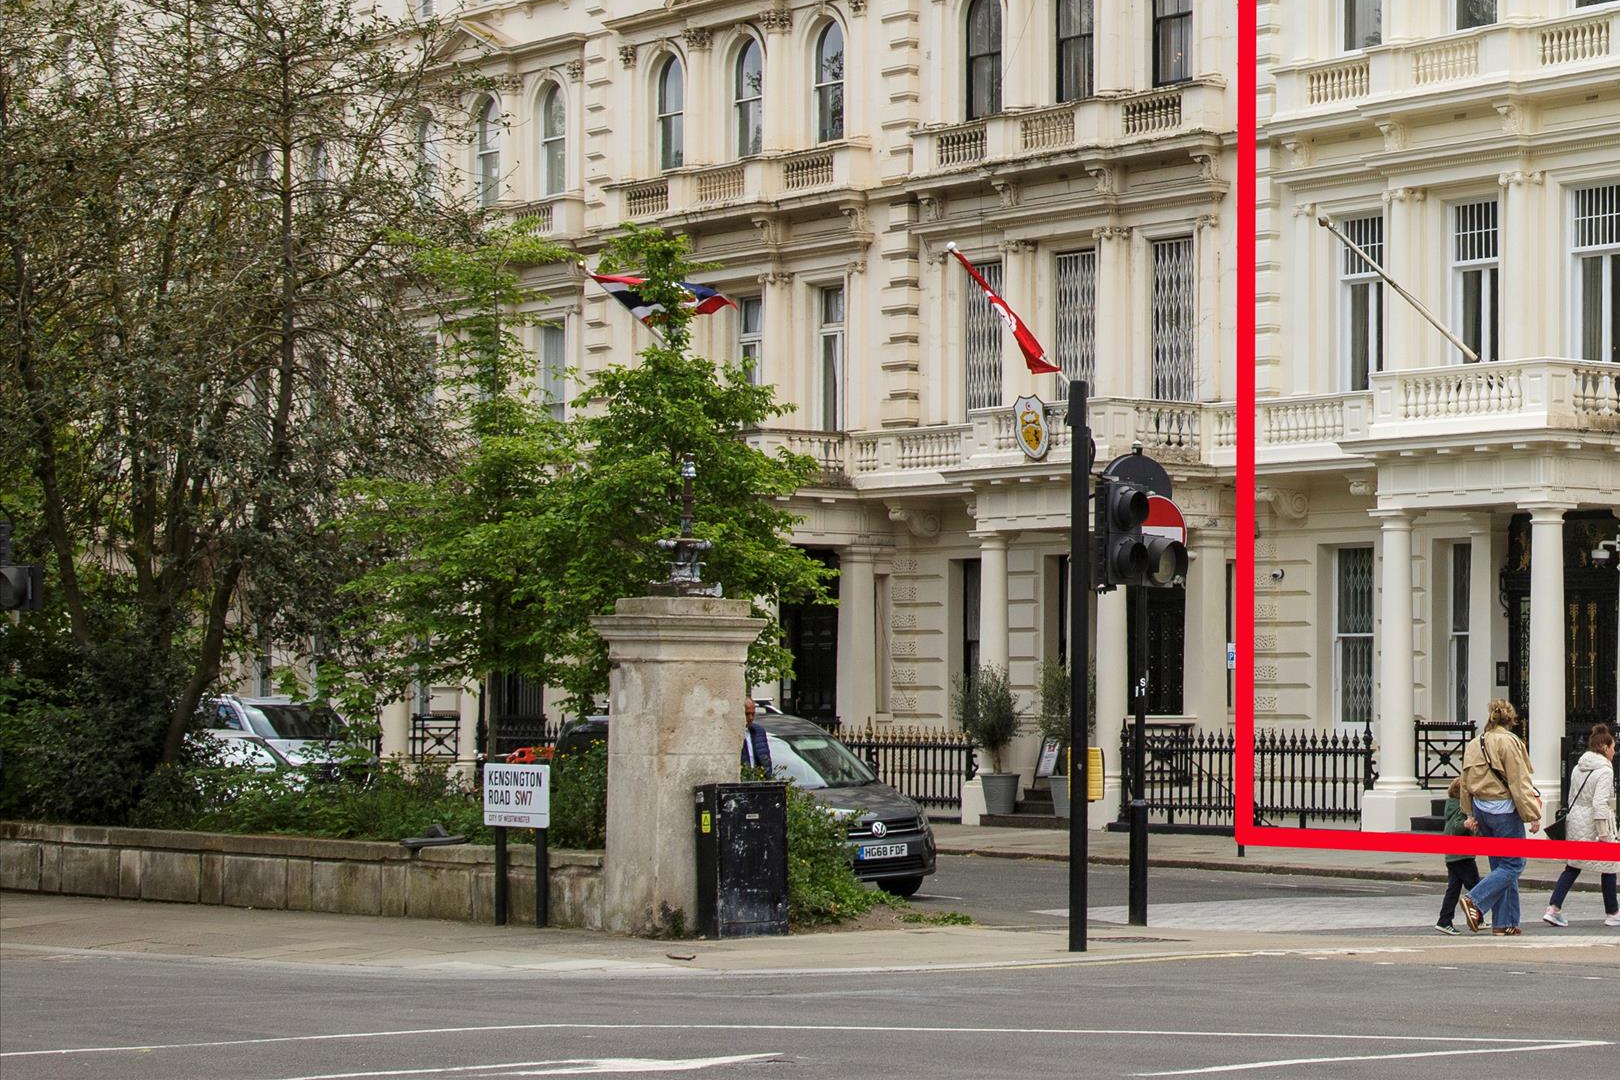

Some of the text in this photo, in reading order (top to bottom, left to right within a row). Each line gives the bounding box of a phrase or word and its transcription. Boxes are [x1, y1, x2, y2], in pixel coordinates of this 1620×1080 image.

[488, 770, 542, 787] KENSINGTON
[488, 789, 533, 806] ROAD SW7
[865, 845, 906, 857] HG68 FDF
